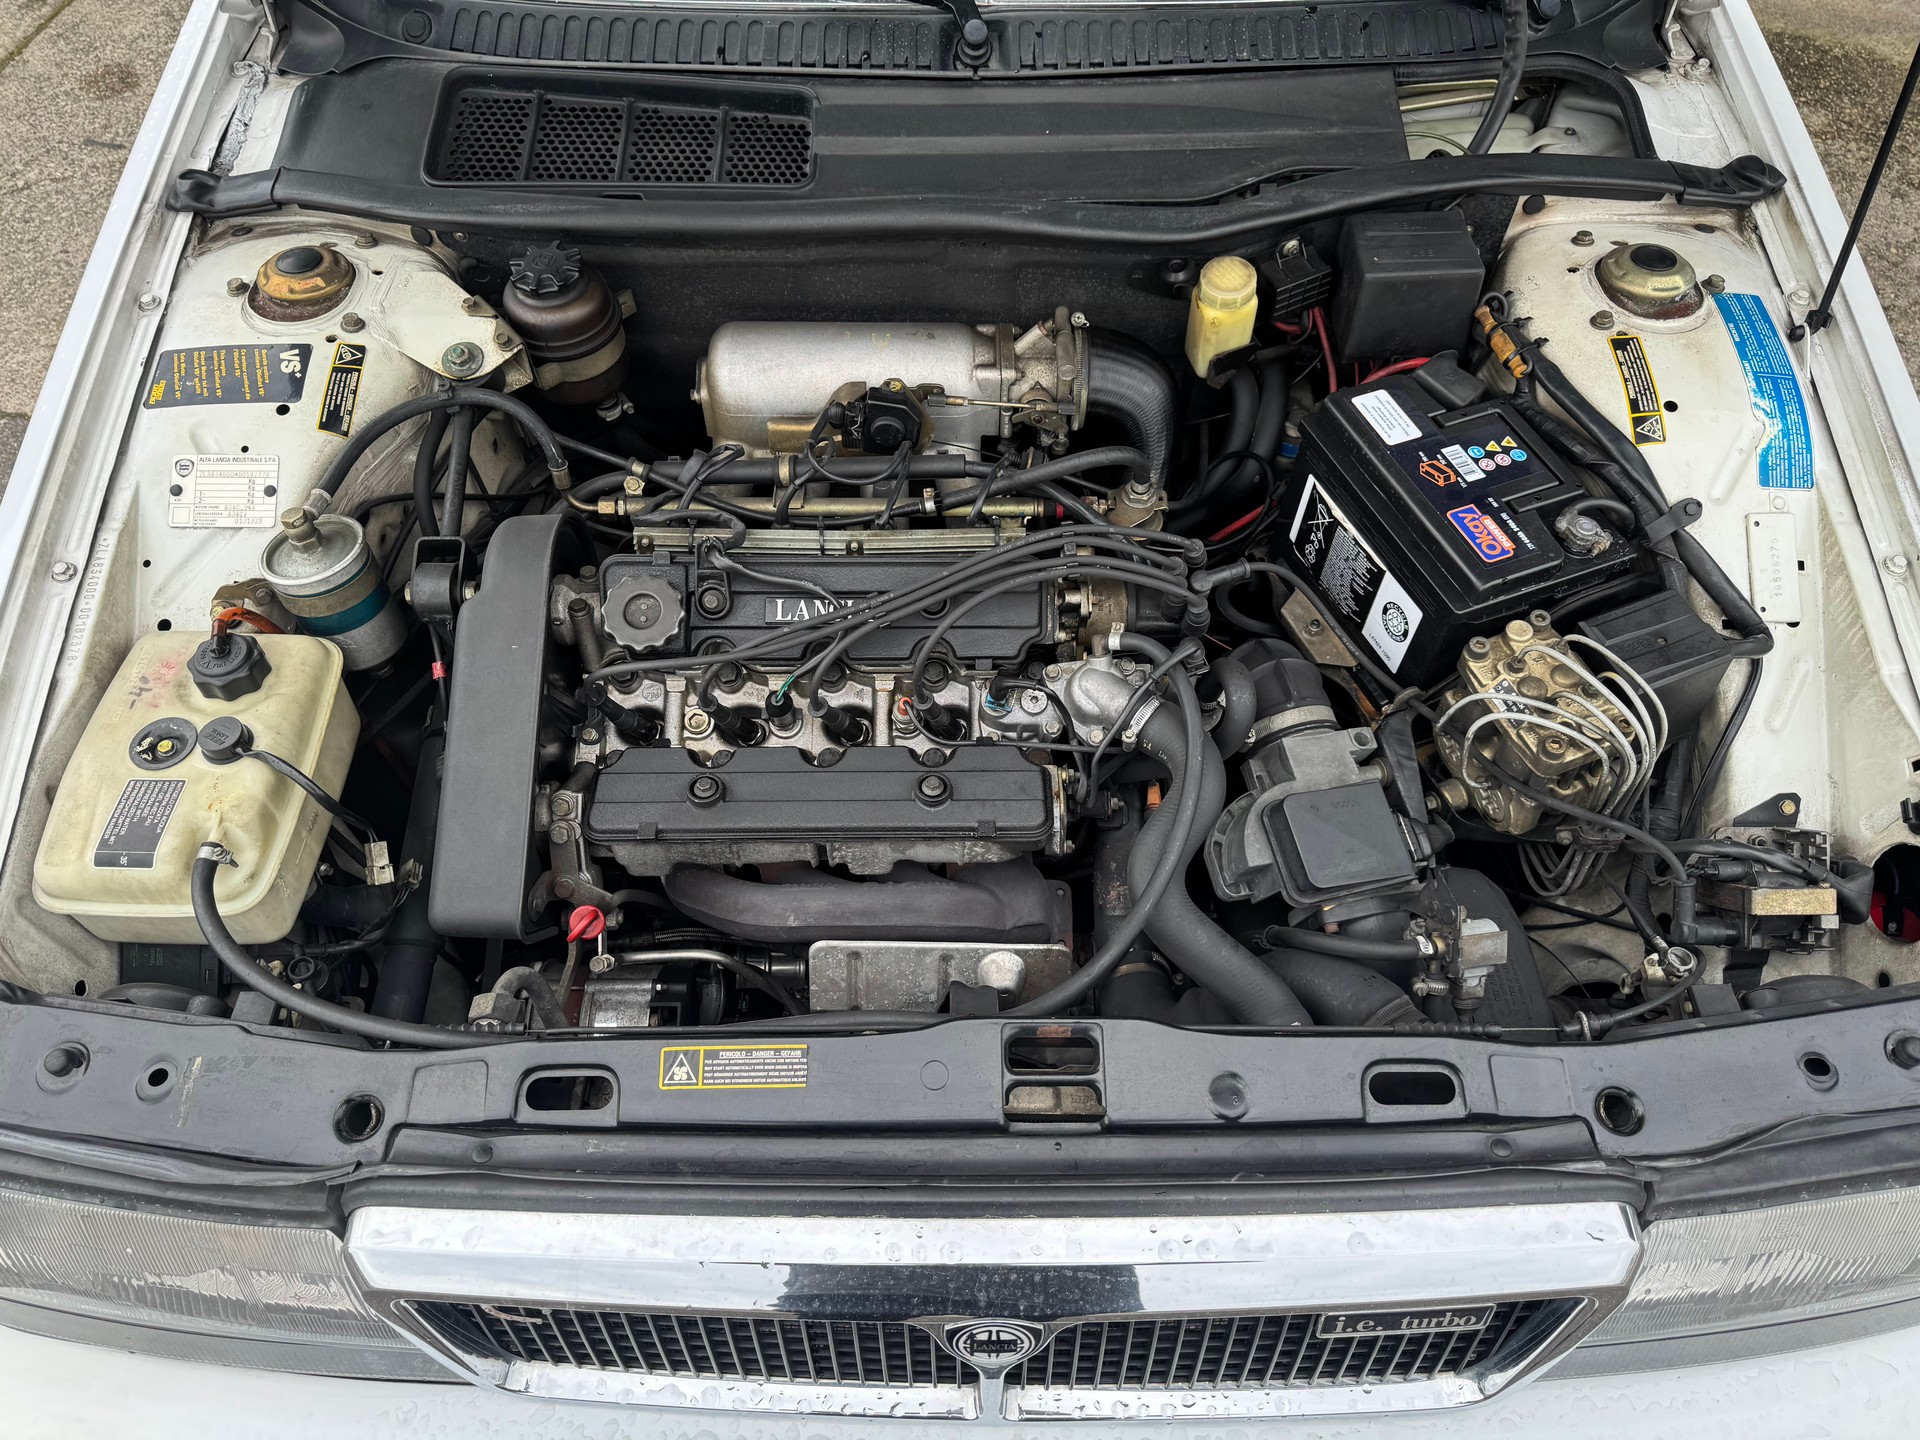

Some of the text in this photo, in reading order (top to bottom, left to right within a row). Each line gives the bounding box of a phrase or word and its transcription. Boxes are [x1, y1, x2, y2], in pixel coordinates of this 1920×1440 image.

[1457, 513, 1501, 556] Okay
[1482, 517, 1511, 547] POWER
[1333, 1312, 1477, 1333] i.e. turbo
[973, 1342, 1017, 1351] LANCIA
